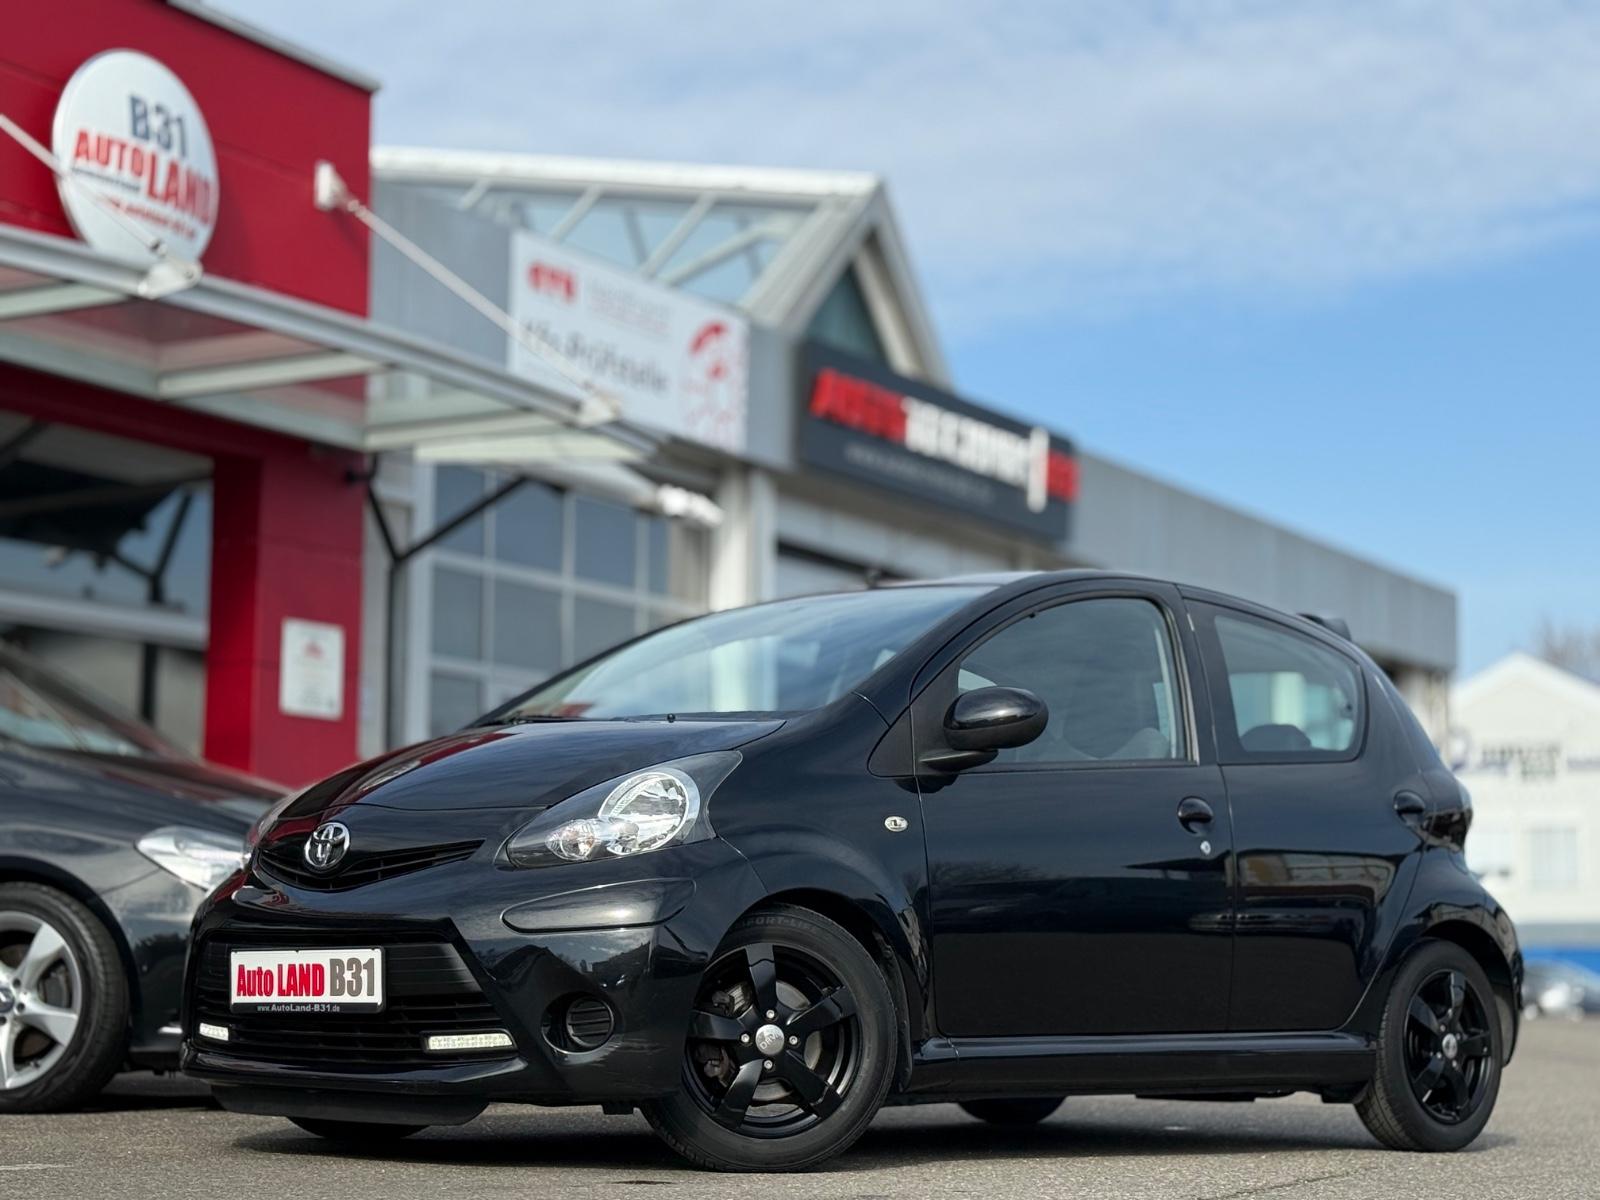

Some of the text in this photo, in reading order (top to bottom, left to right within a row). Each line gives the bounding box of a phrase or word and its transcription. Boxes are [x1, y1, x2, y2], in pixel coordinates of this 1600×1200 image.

[130, 94, 187, 158] B31
[236, 957, 375, 996] Auto LAND B31
[257, 1003, 341, 1013] www.AutoLand-B31.de
